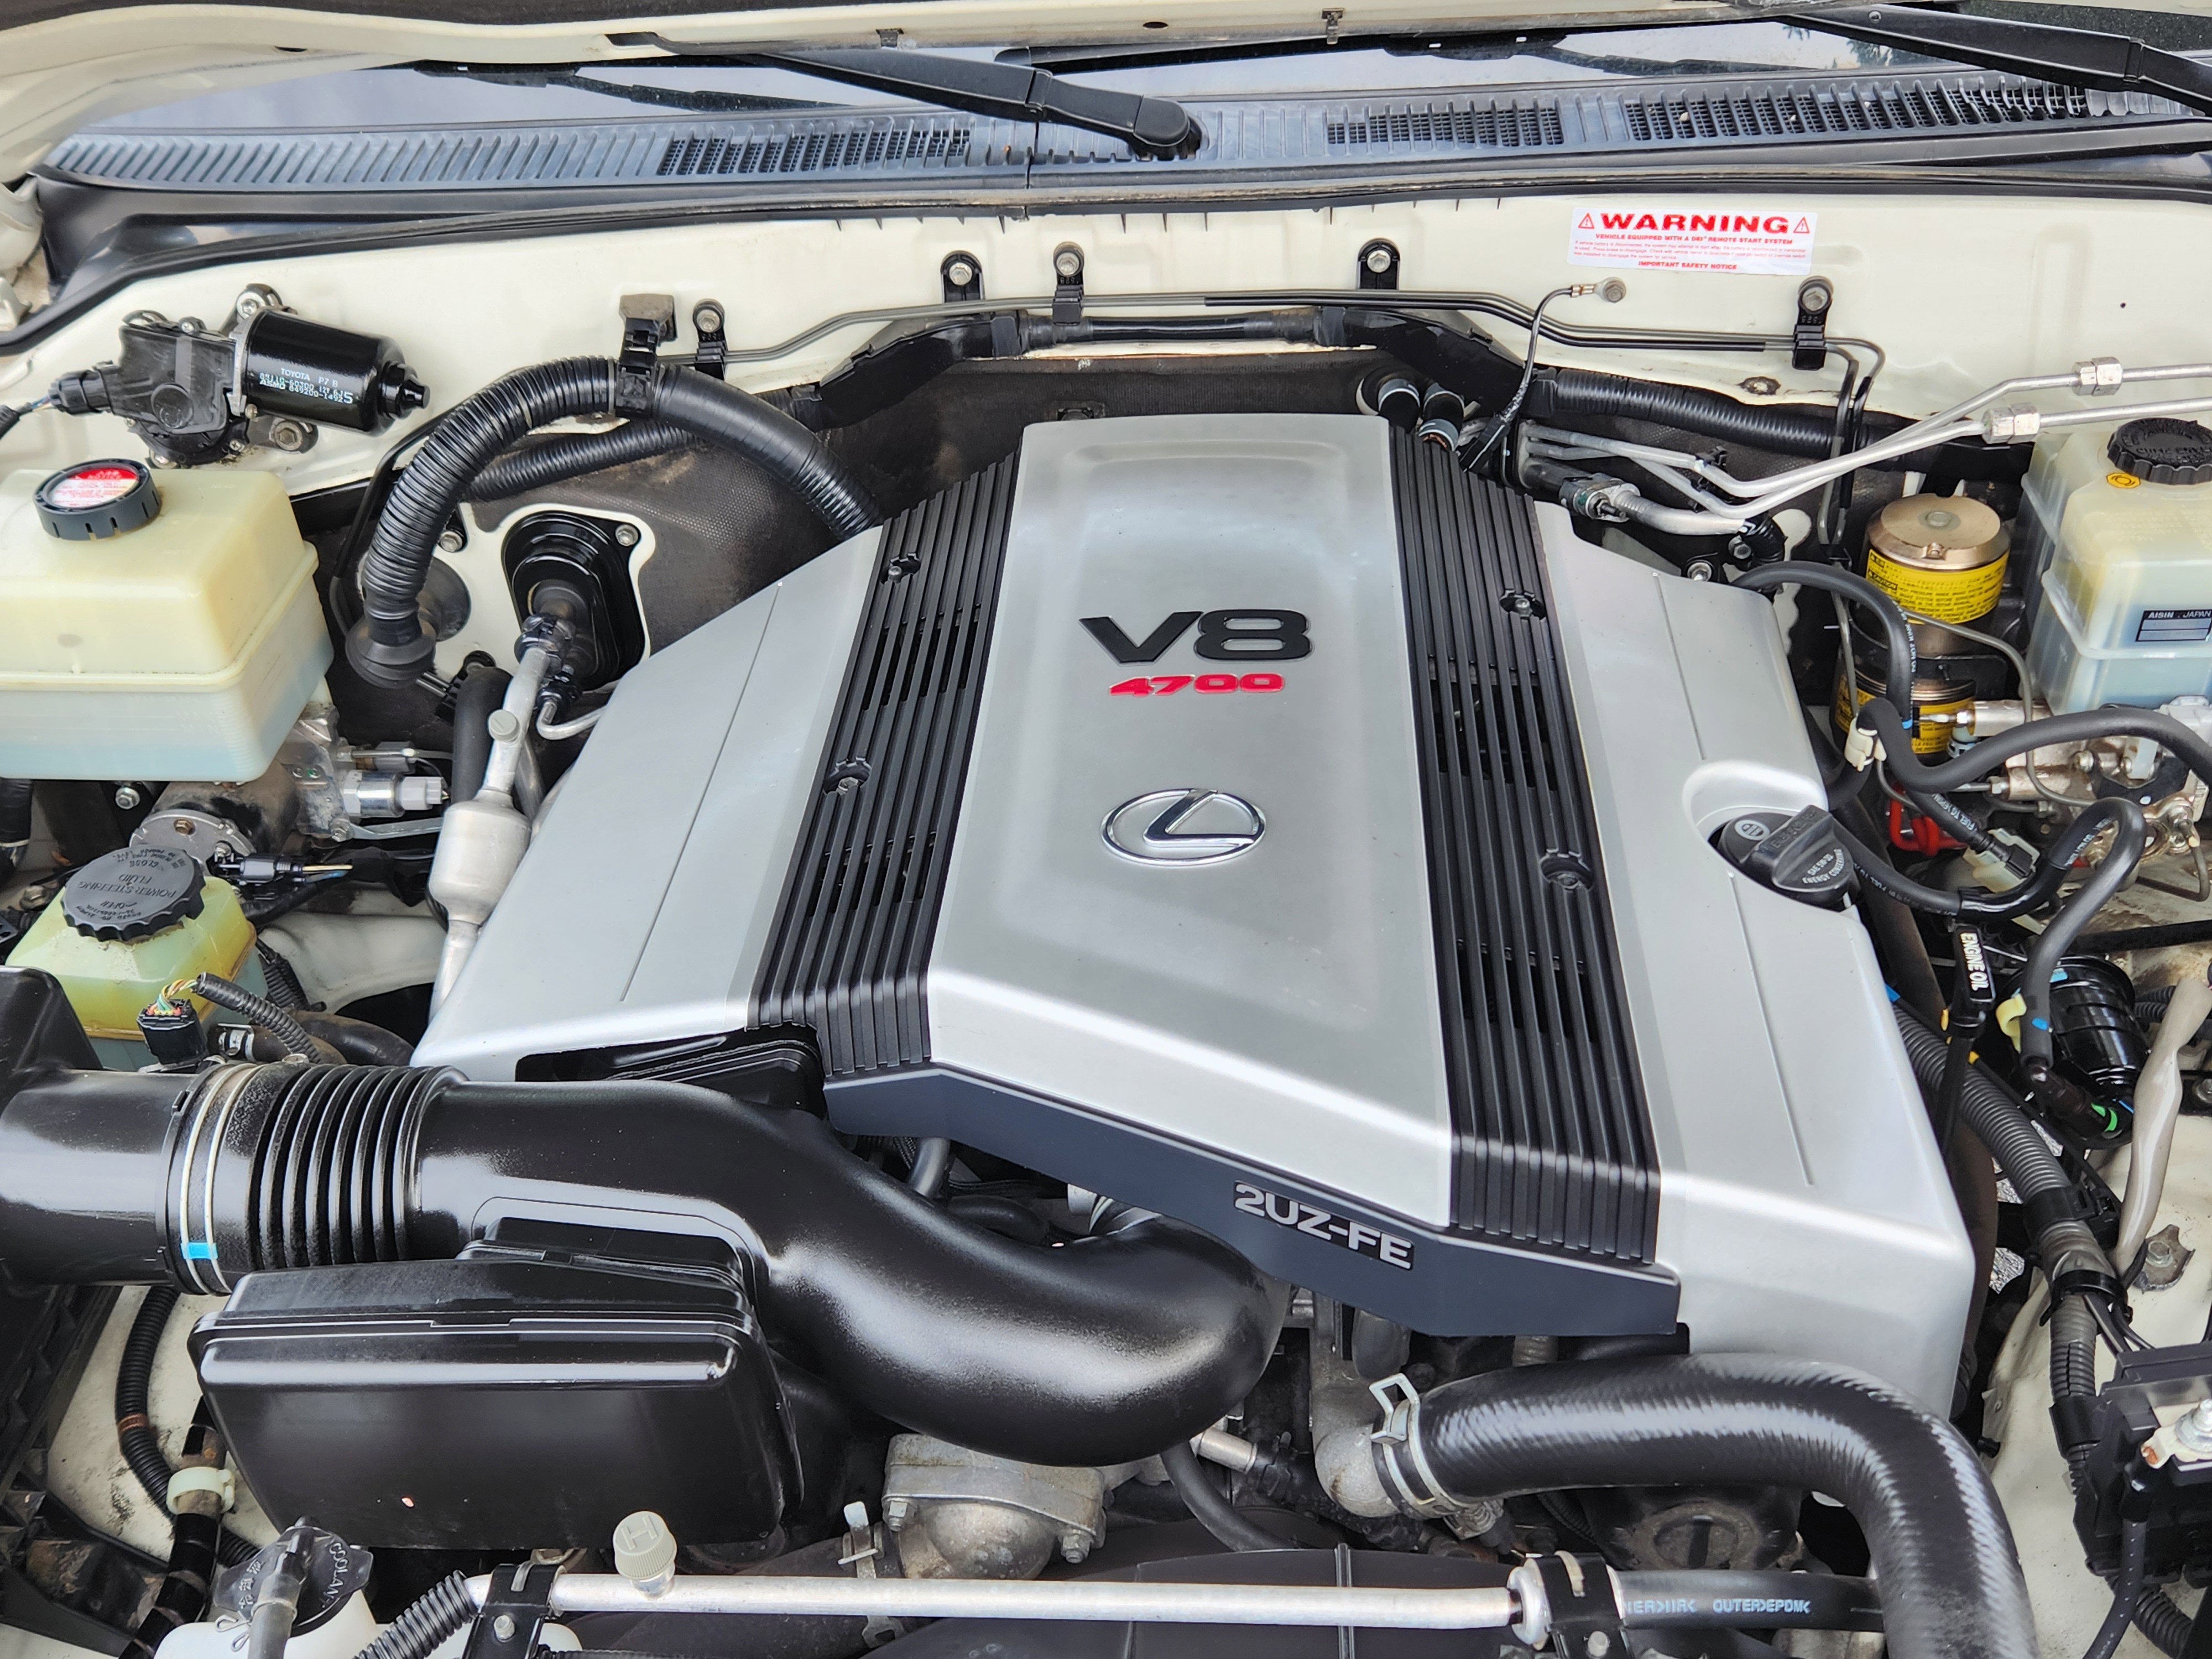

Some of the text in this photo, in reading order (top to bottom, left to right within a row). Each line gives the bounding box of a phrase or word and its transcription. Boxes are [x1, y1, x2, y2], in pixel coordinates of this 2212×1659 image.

[1600, 213, 1789, 233] WARNING
[281, 368, 310, 381] TOYOTA
[343, 390, 354, 404] 5
[1078, 609, 1312, 665] V8
[1109, 672, 1285, 697] 4700
[78, 881, 177, 898] POWER STEERING
[118, 874, 153, 884] FLUID
[1960, 932, 1990, 990] ENGINE OIL
[1234, 1183, 1412, 1270] 2UZ-FE
[620, 1515, 659, 1551] H
